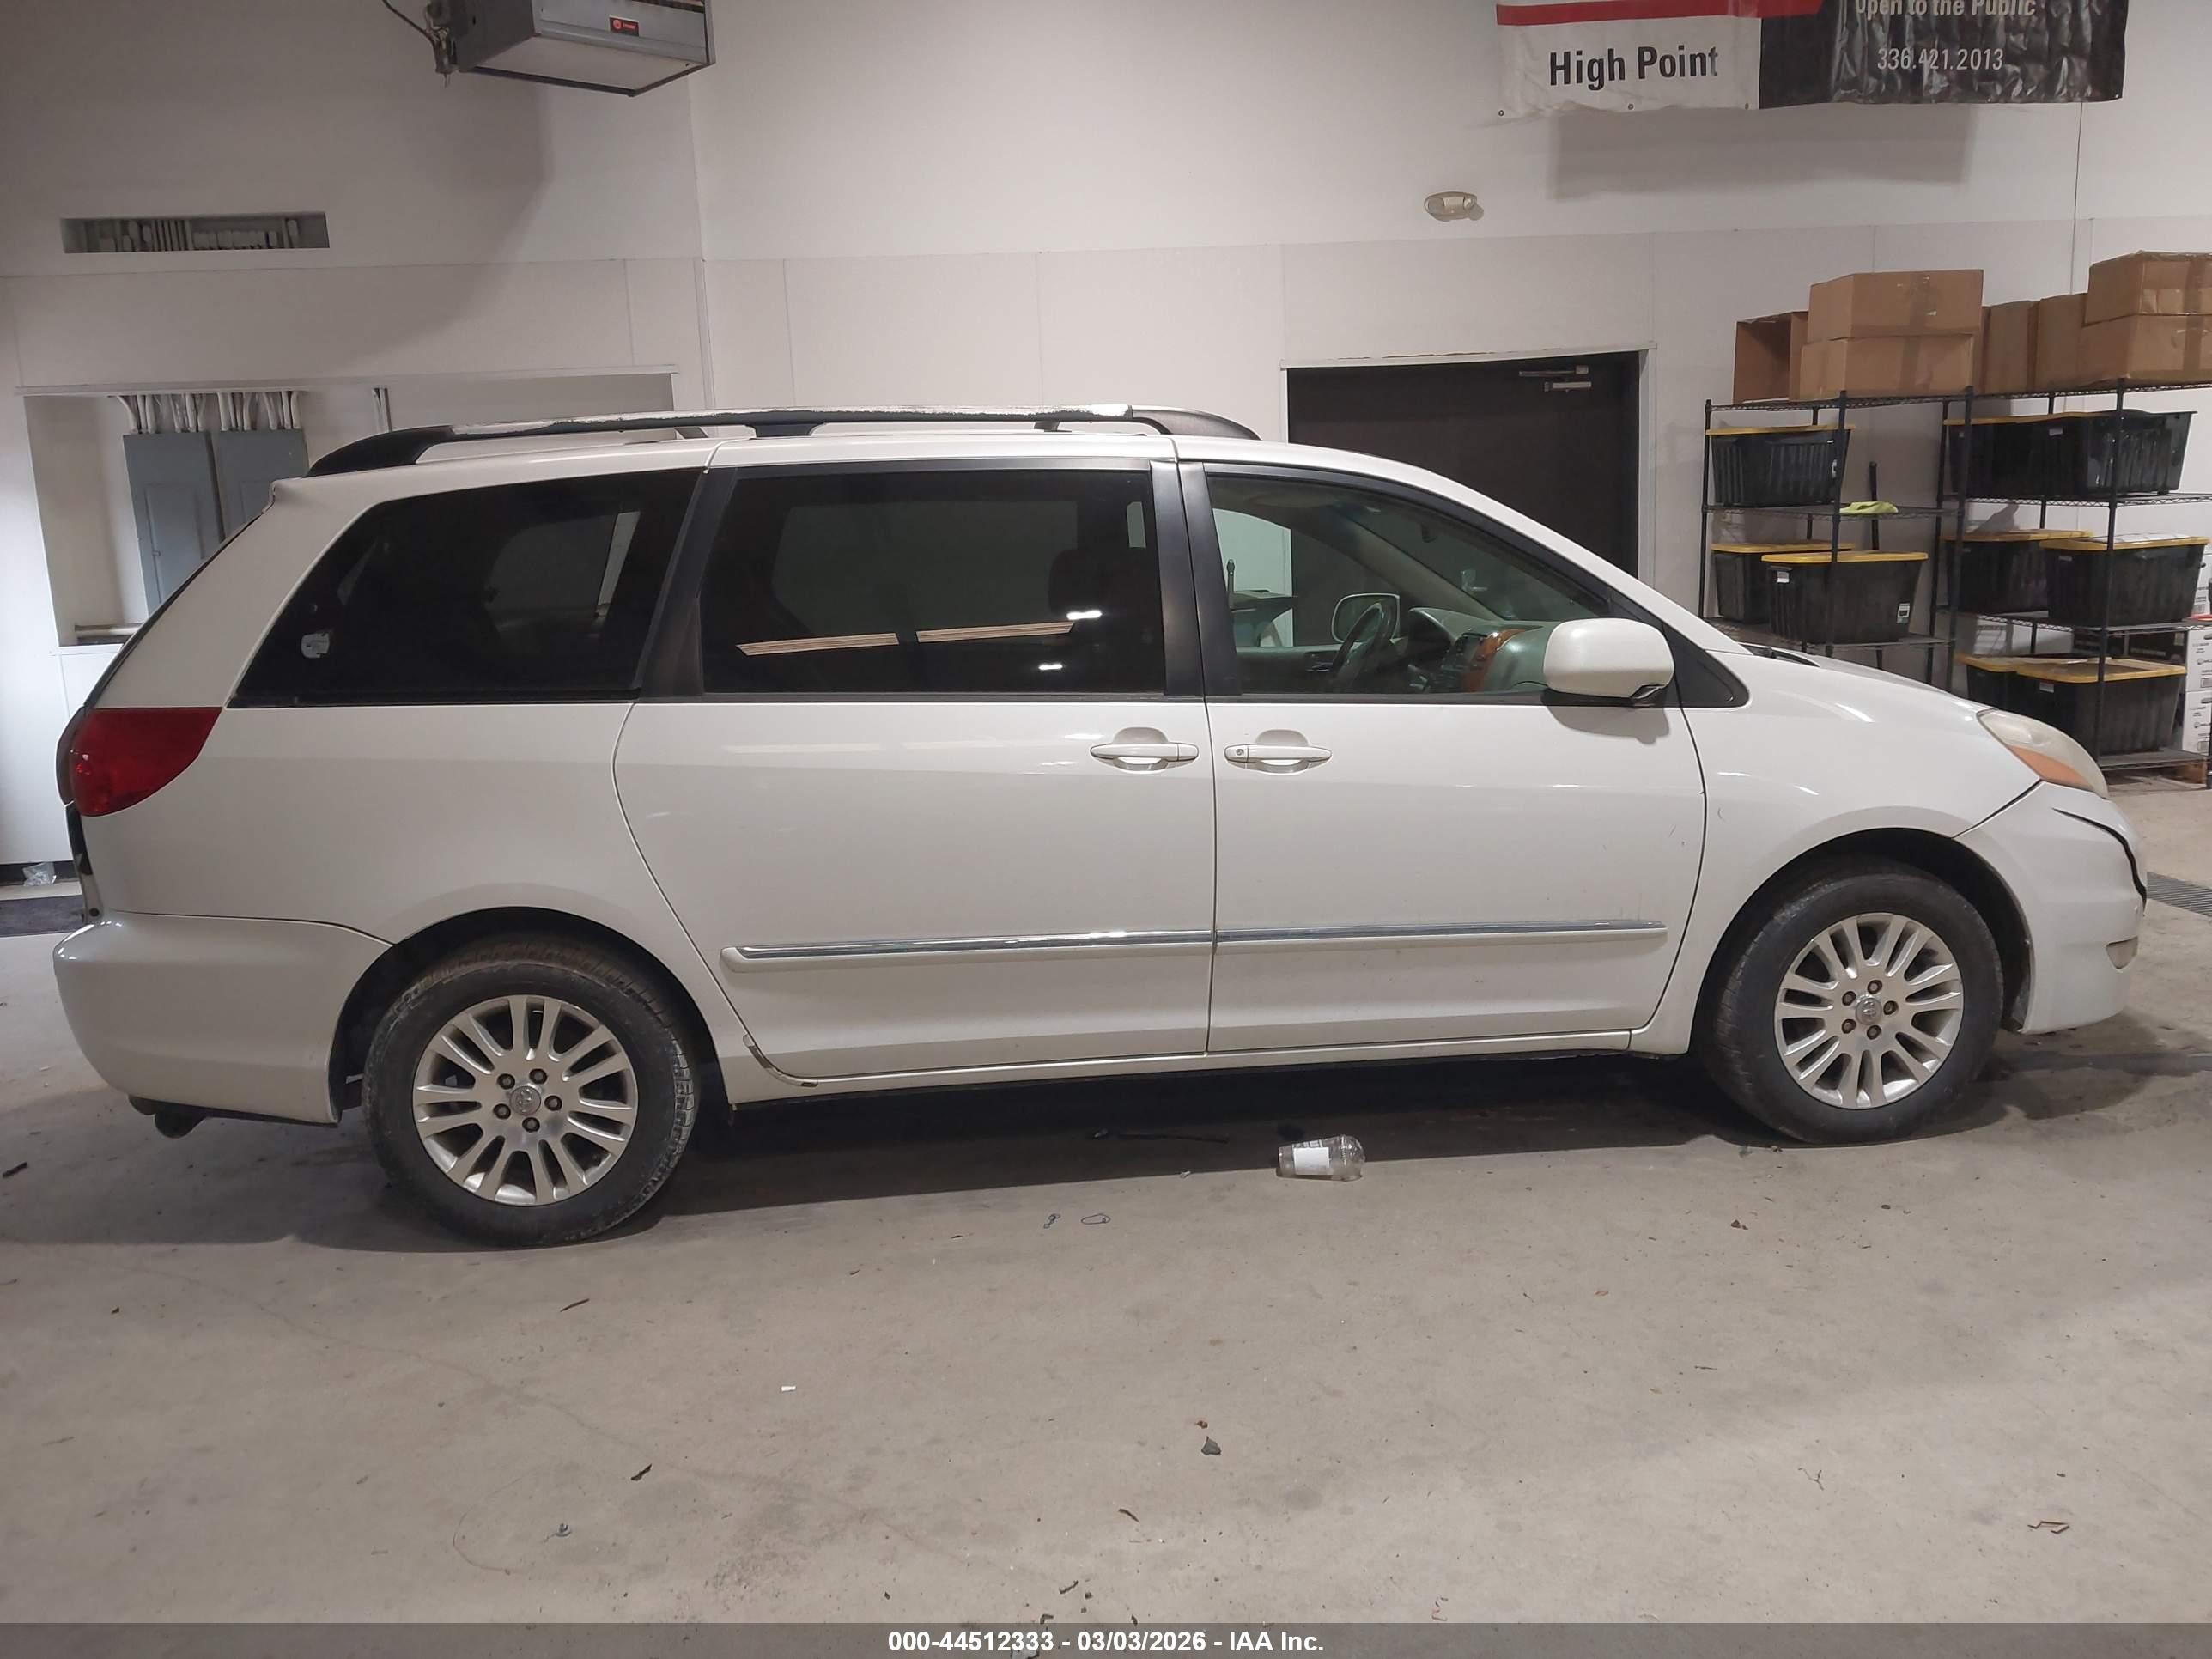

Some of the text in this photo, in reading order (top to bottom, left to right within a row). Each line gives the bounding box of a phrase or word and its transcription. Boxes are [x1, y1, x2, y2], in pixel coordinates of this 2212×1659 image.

[1855, 0, 2037, 21] Open to the Public
[1549, 45, 1718, 91] High Point
[1877, 47, 2004, 70] 336.421.2013
